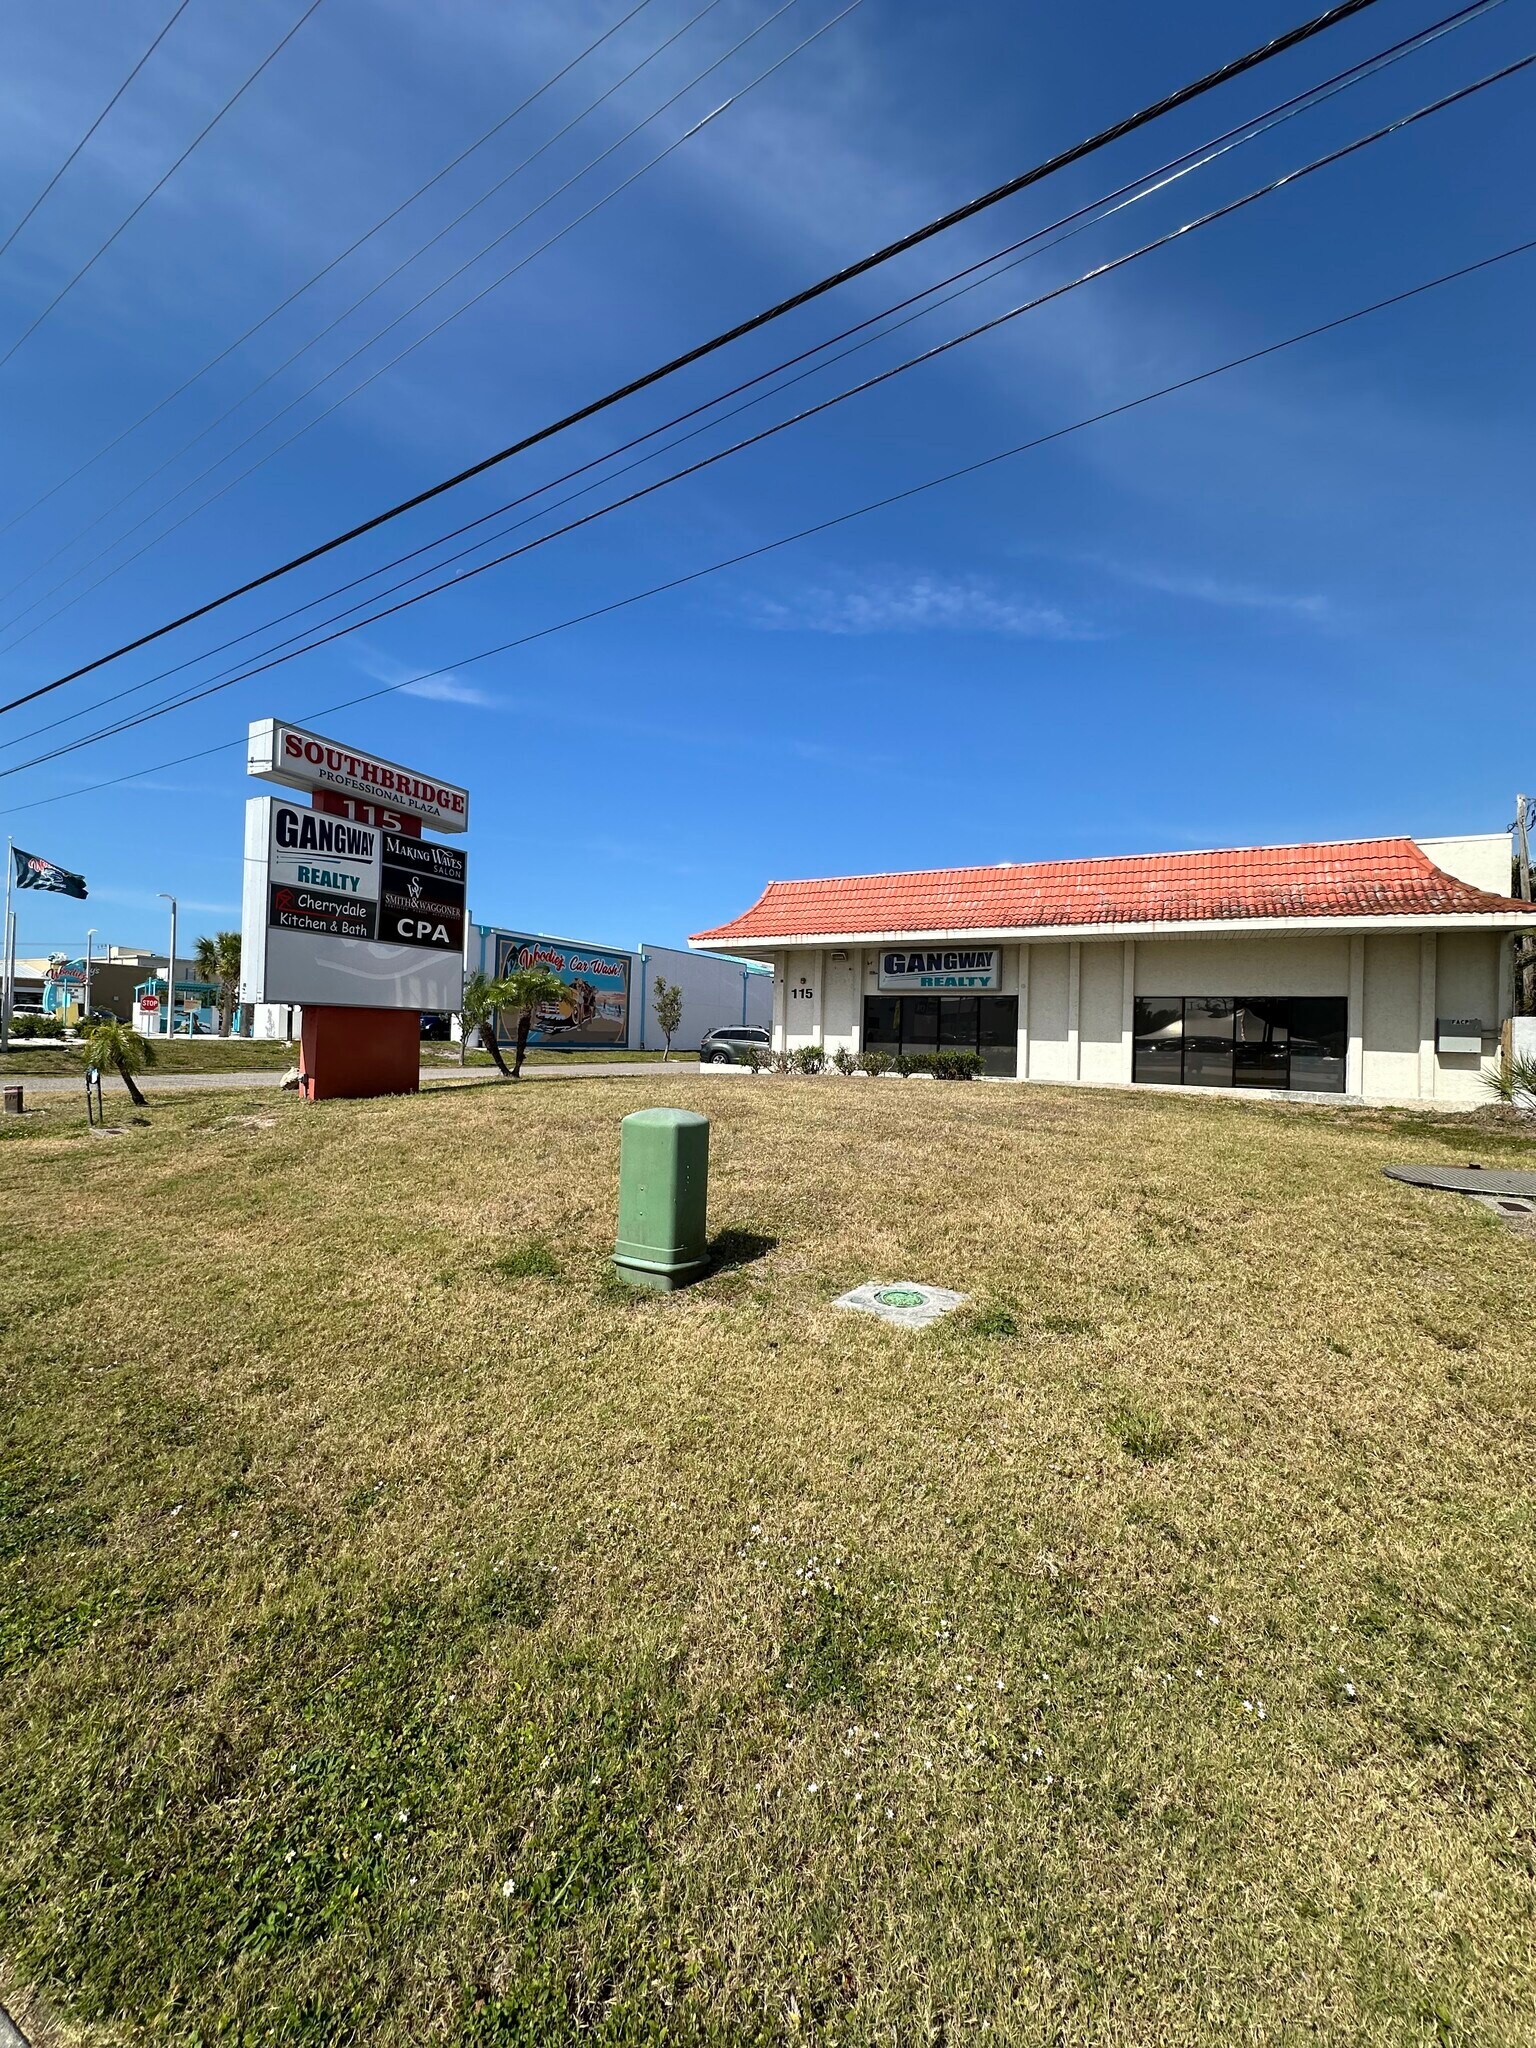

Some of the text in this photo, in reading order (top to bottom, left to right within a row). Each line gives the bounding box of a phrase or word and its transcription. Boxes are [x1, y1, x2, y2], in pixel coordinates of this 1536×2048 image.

[285, 734, 464, 814] SOUTHBRIDGE
[319, 768, 441, 816] PROFESSIONAL PLAZA
[343, 800, 402, 832] 115
[276, 808, 375, 856] GANGWAY
[297, 865, 360, 892] REALTY
[433, 865, 461, 878] SALON
[298, 894, 367, 918] Cherrydale
[280, 911, 367, 936] Kitchen & Bath
[397, 918, 450, 943] CPA
[569, 955, 589, 973] Car
[590, 958, 624, 977] Wash!
[884, 951, 994, 974] GANGWAY
[791, 988, 813, 999] 115
[920, 976, 991, 987] REALTY
[142, 999, 158, 1007] STOP
